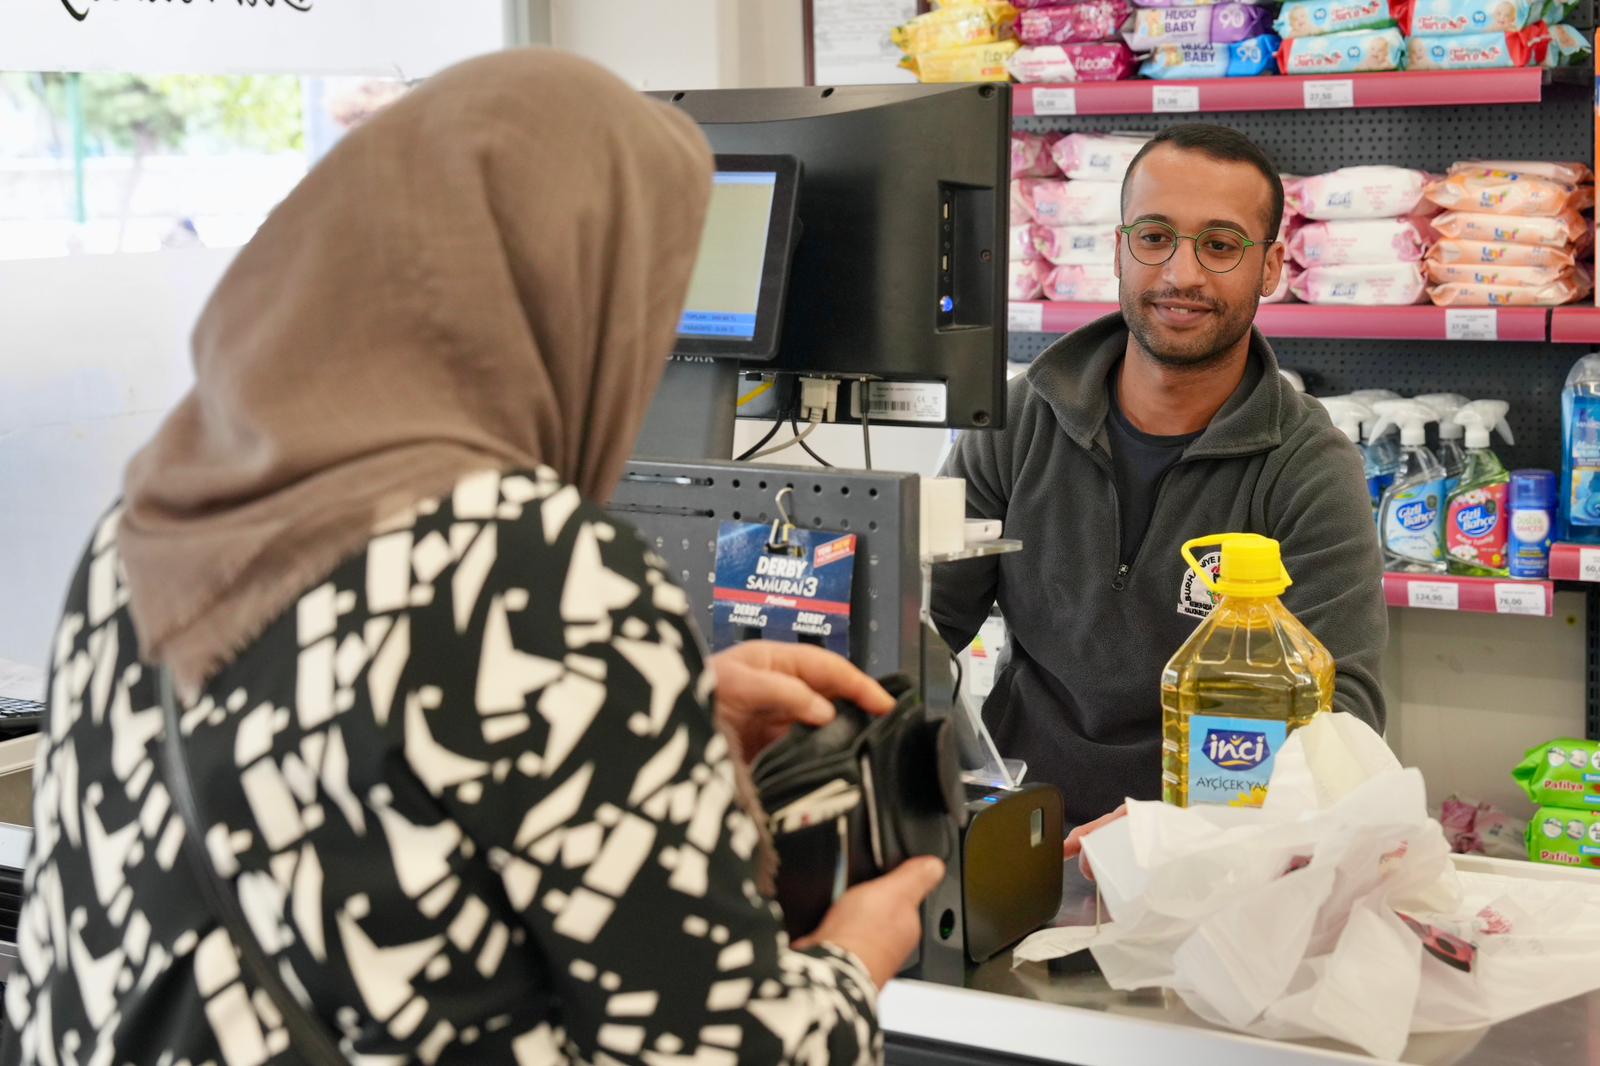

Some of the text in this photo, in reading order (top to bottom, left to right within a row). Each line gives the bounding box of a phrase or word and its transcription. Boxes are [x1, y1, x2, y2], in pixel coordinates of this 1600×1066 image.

[1164, 21, 1197, 33] BABY
[1183, 51, 1216, 63] BABY
[1398, 502, 1423, 518] Gizli
[1457, 507, 1482, 523] Gizli
[1404, 510, 1437, 527] Bahçe
[1463, 514, 1497, 531] Bahçe
[755, 556, 808, 579] DERBY
[733, 603, 762, 616] DERBY
[796, 611, 826, 625] DERBY
[1195, 775, 1245, 792] AYÇİÇEK
